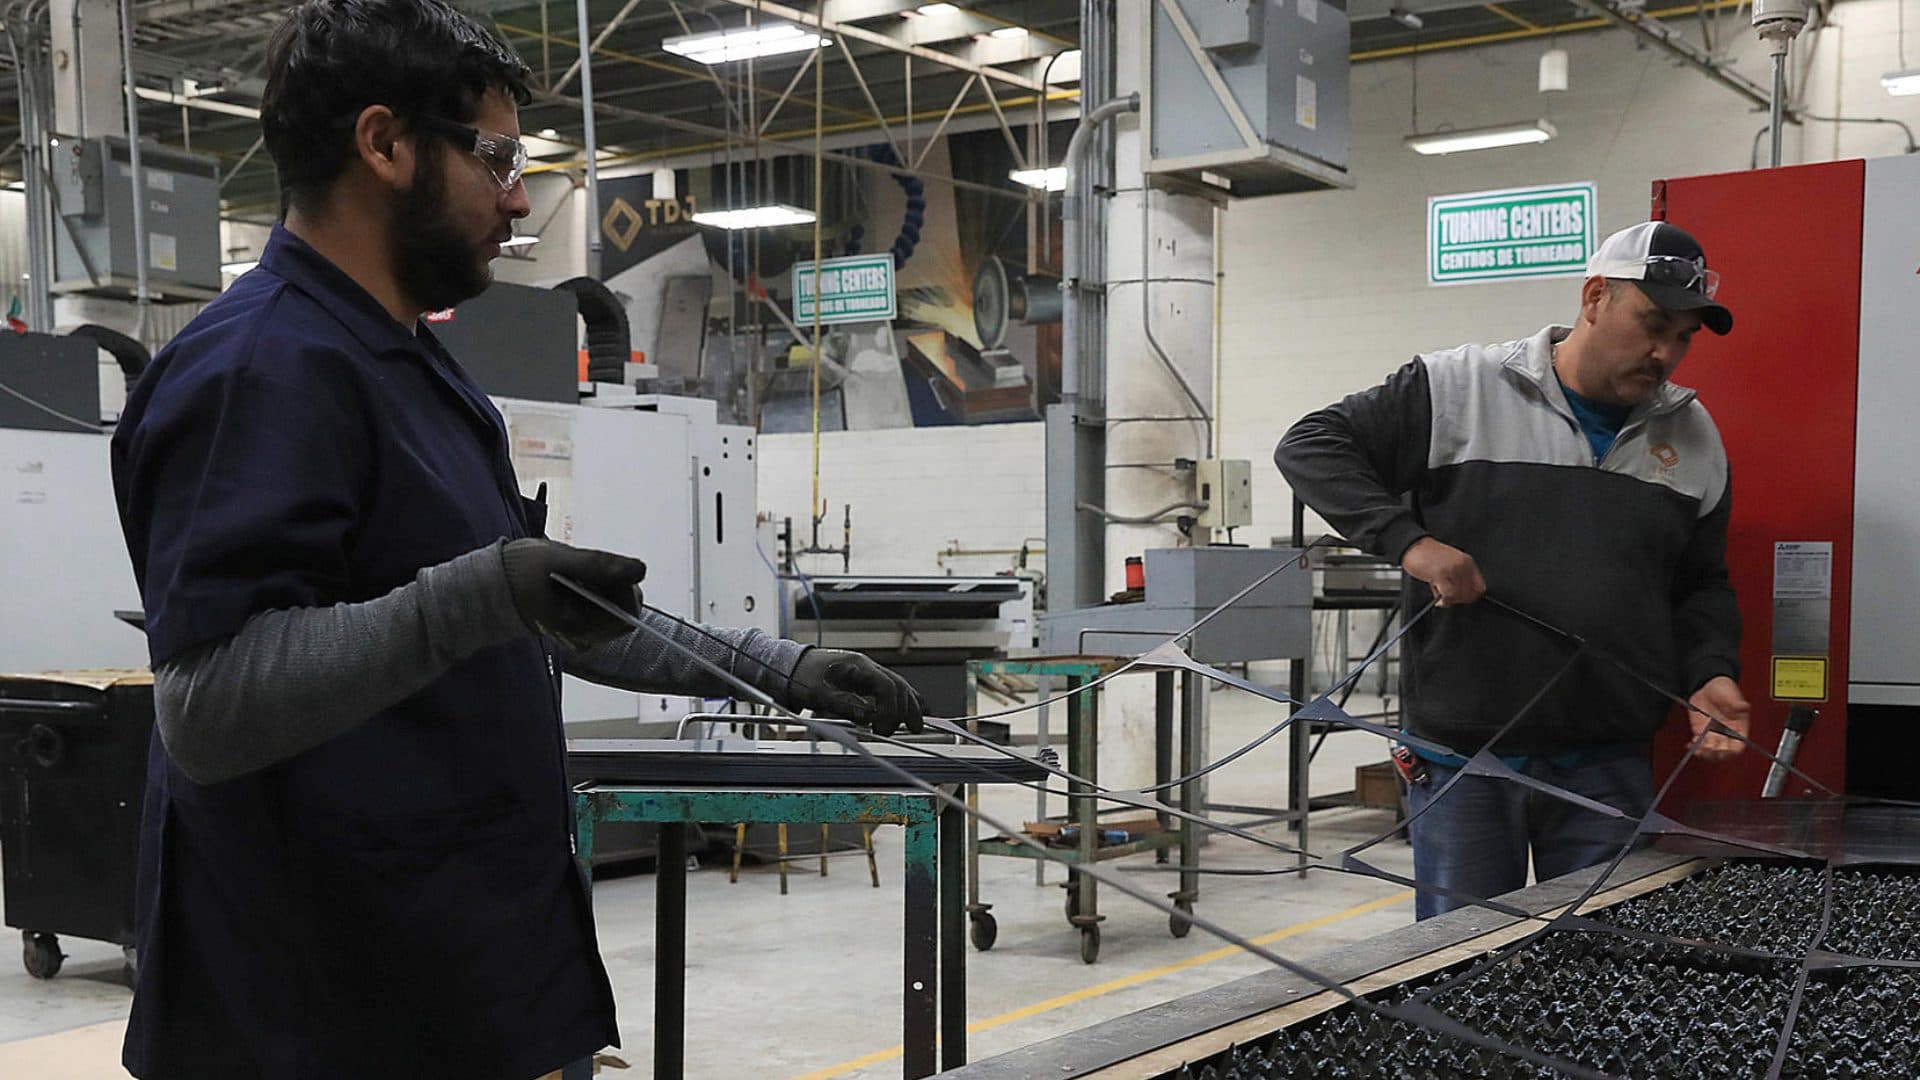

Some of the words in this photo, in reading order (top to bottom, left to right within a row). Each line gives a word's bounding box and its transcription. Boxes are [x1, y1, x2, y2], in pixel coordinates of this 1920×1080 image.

[645, 195, 697, 225] TDJ
[1440, 207, 1507, 244] TURNING
[1510, 202, 1582, 238] CENTERS
[1441, 248, 1495, 271] CENTROS
[1497, 249, 1514, 266] DE
[1515, 243, 1583, 265] TORNEADO
[842, 266, 886, 291] CENTERS
